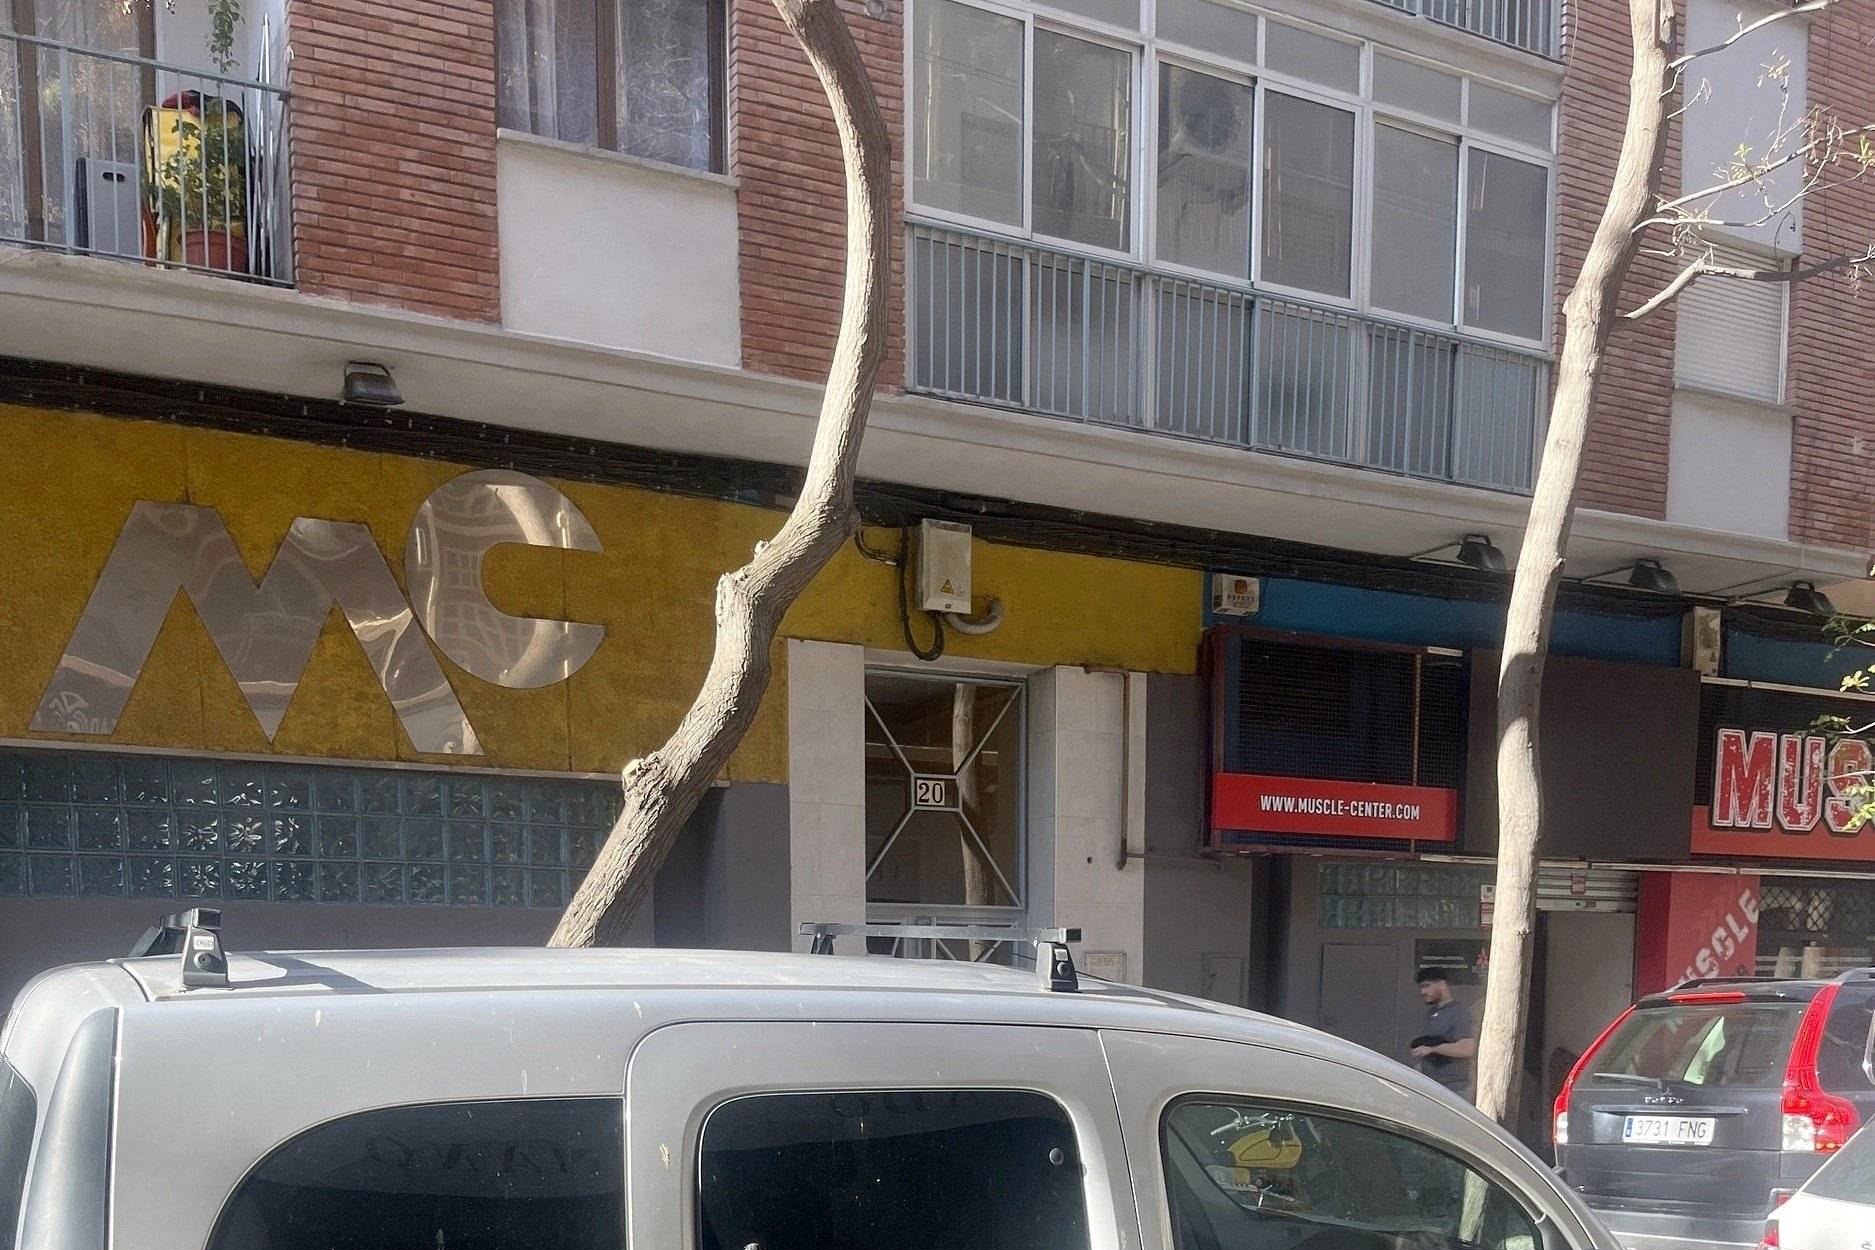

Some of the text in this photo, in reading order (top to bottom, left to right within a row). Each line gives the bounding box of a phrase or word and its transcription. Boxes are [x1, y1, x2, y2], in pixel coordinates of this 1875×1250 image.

[28, 469, 606, 755] MC
[918, 782, 944, 804] 20
[1260, 794, 1420, 821] WWW.MUSCLE-CENTER.COM
[1635, 1120, 1707, 1139] 3731 FNG
